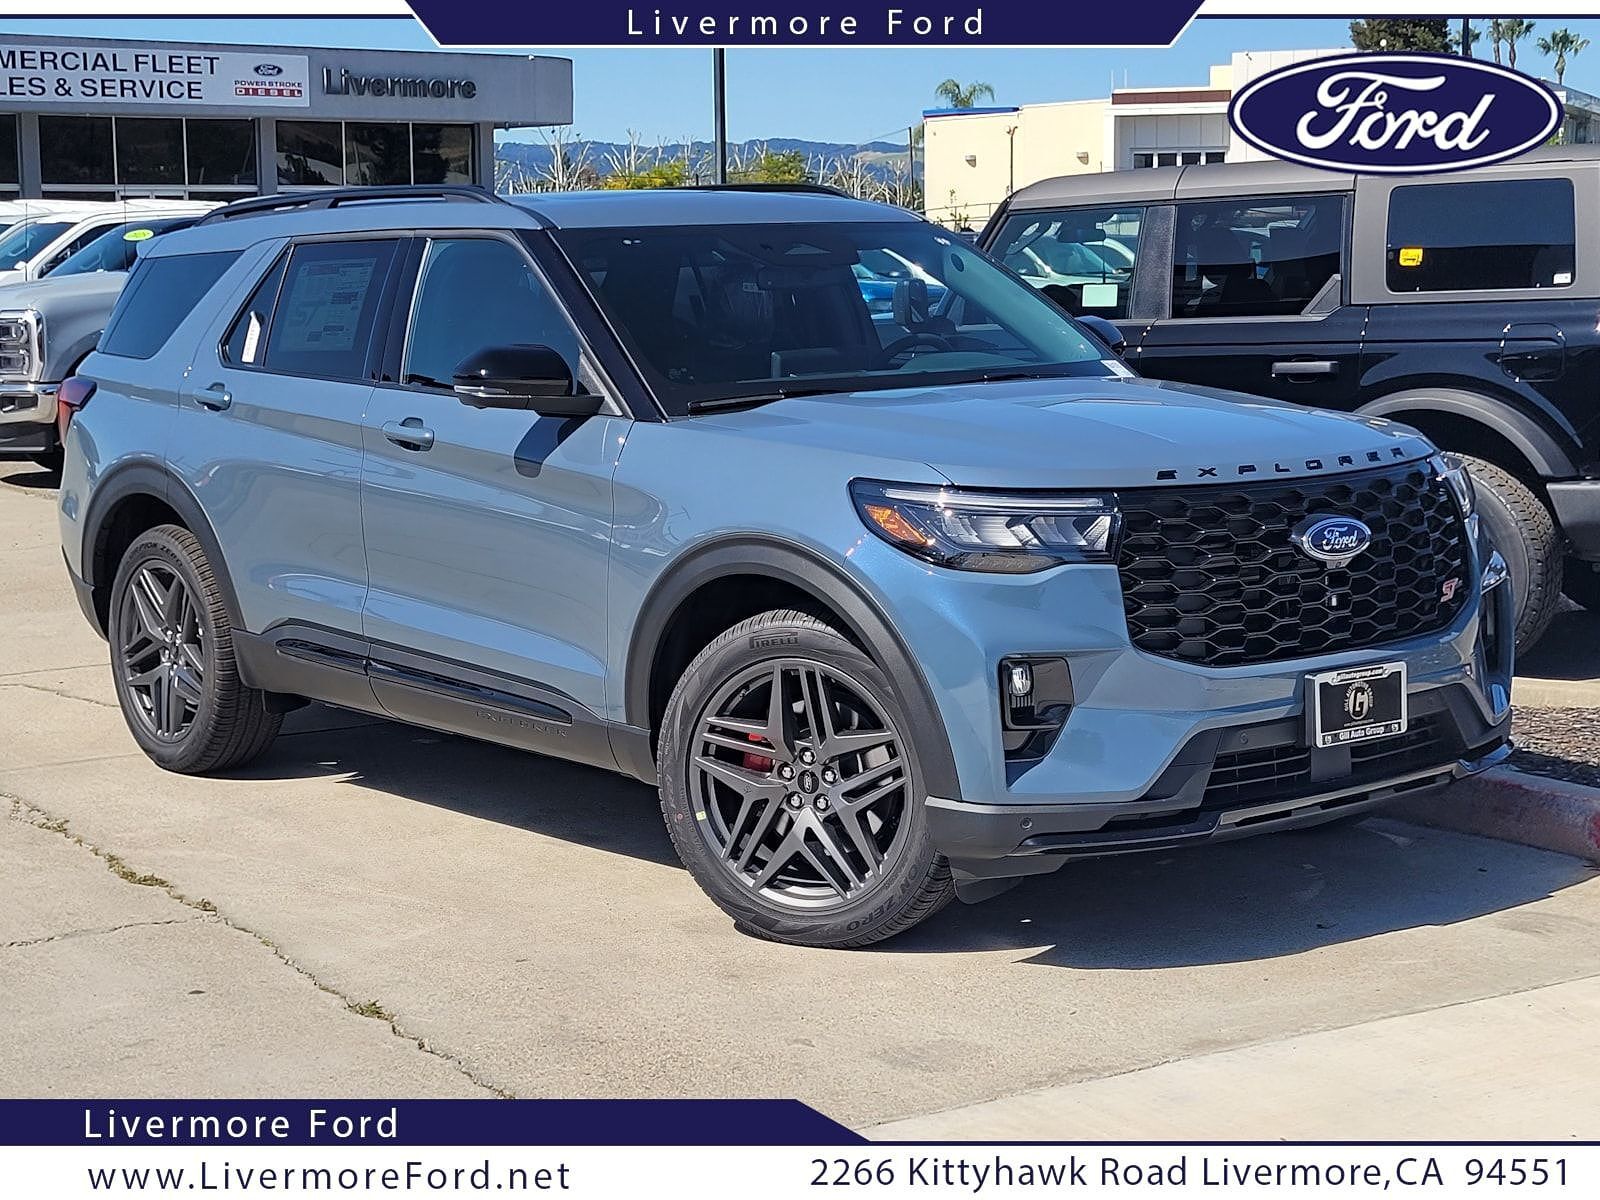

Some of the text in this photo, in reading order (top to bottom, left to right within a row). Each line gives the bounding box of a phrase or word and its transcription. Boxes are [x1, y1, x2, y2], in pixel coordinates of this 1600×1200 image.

[134, 54, 219, 75] FLEET
[54, 78, 73, 97] &
[80, 79, 203, 100] SERVICE
[235, 88, 302, 97] DIESEL
[267, 80, 302, 88] STROKE
[322, 66, 477, 99] Livermore
[1156, 447, 1406, 481] EXPLORER
[1322, 526, 1358, 551] Ford
[750, 631, 799, 649] PIRELLI
[1339, 726, 1385, 740] Gill Auto Group
